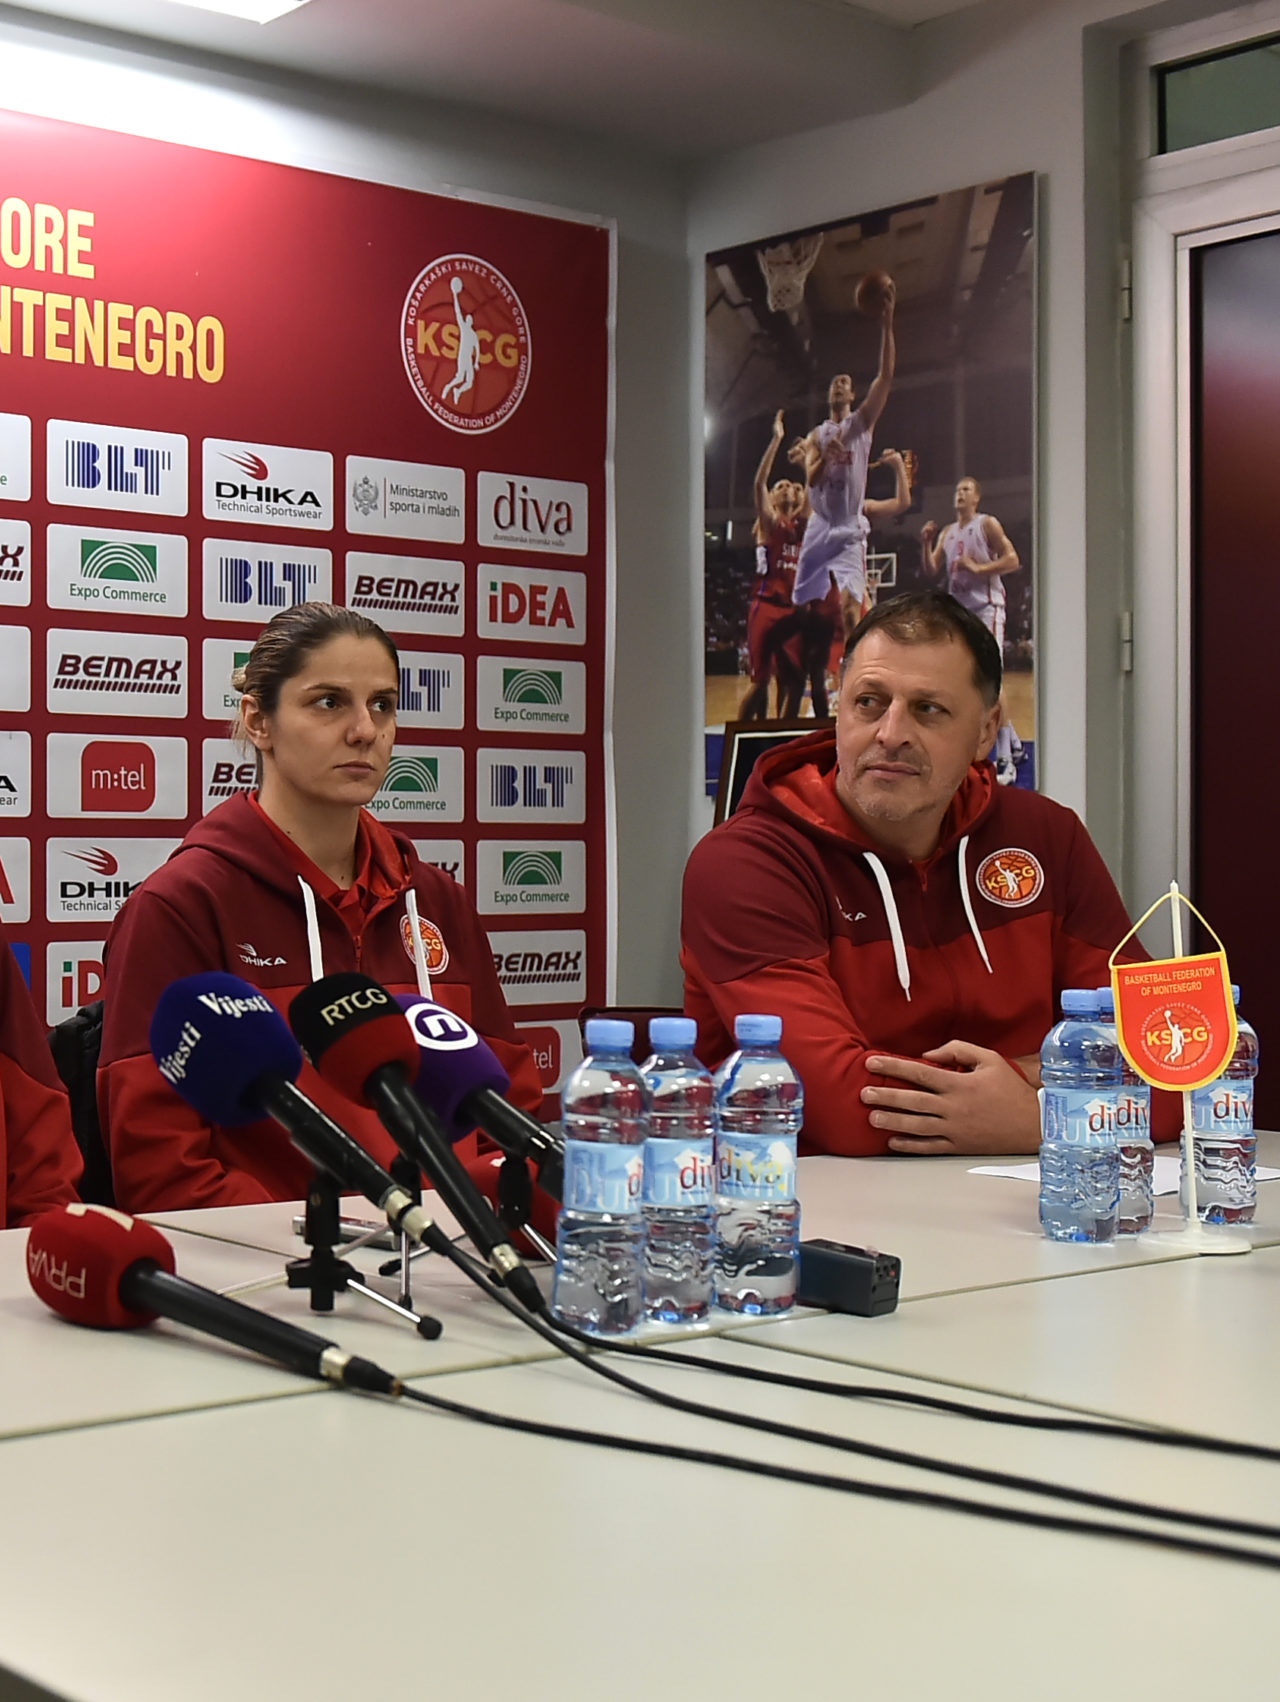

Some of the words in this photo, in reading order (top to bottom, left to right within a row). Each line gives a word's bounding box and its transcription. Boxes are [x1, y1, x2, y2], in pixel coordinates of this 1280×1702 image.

[455, 261, 488, 278] SAVEZ
[489, 275, 514, 304] CRNE
[511, 306, 527, 344] GORE
[405, 338, 433, 406] BASKETBALL
[433, 401, 484, 428] FEDERATION
[484, 413, 498, 426] OF
[497, 355, 528, 418] MONTENEGRO
[64, 439, 172, 497] BLT
[215, 481, 322, 507] DHIKA
[390, 484, 448, 501] Ministarstvo
[216, 499, 262, 513] Technical
[266, 505, 321, 519] Sportswear
[390, 502, 420, 514] sporta
[422, 503, 426, 514] i
[428, 504, 460, 517] mladih
[494, 481, 572, 536] diva
[70, 584, 99, 600] Expo
[103, 586, 166, 603] Commerce
[355, 576, 460, 603] BEMAX
[58, 654, 182, 681] BEMAX
[495, 707, 518, 722] Expo
[520, 709, 569, 722] Commerce
[92, 764, 145, 789] m:tel
[392, 797, 446, 810] Commerce
[60, 882, 143, 898] DHIK
[495, 891, 517, 905] Expo
[520, 891, 570, 902] Commerce
[61, 900, 111, 911] Technical
[239, 954, 288, 967] DHIKA
[1124, 971, 1171, 985] BASKETBALL
[1172, 967, 1215, 981] FEDERATION
[1141, 986, 1151, 996] OF
[1153, 981, 1202, 995] MONTENEGRO
[197, 991, 274, 1019] Vijesti
[320, 987, 388, 1027] RTCG
[1146, 1026, 1208, 1046] KSCG
[158, 1021, 202, 1085] Vijesti
[719, 1148, 782, 1185] diva
[28, 1243, 86, 1299] PRVA
